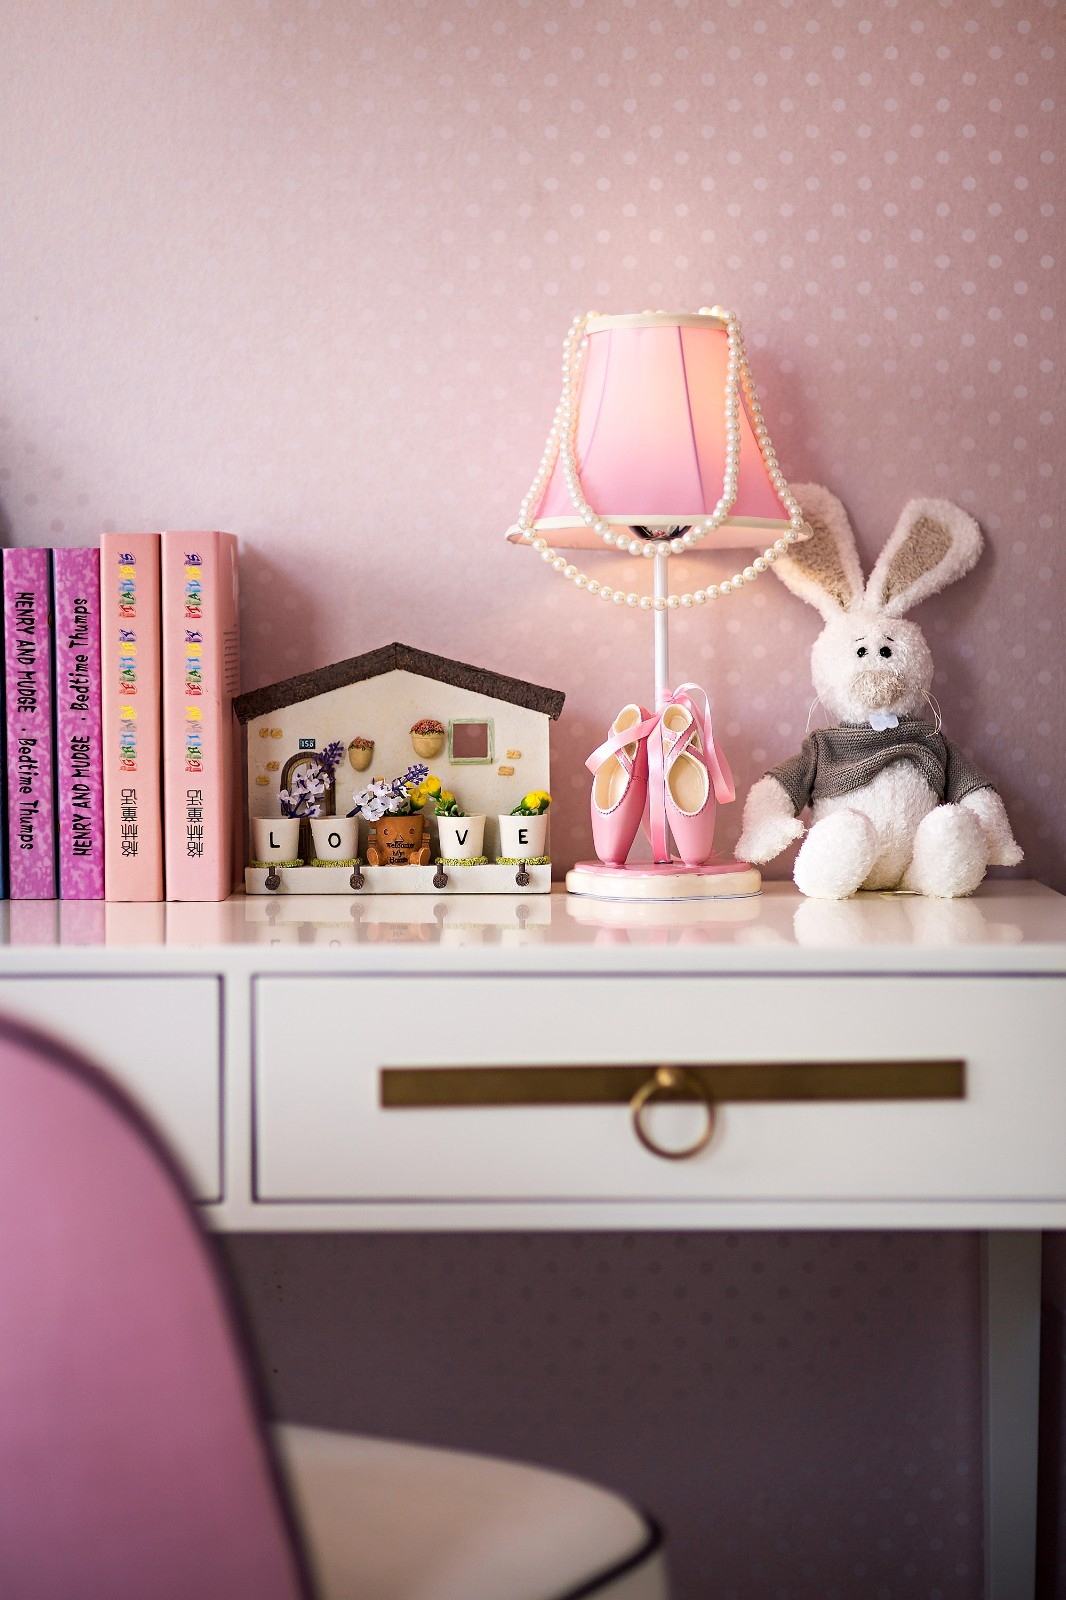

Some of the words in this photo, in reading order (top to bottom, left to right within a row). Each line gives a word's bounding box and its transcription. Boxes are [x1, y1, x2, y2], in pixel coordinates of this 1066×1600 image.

[118, 552, 136, 618] TALES
[183, 552, 202, 619] TALES
[15, 593, 35, 634] HENRY
[68, 599, 90, 648] Thumps
[16, 640, 35, 664] AND
[119, 629, 137, 695] FAIRY
[184, 629, 203, 696] FAIRY
[17, 671, 37, 713] MUDGE
[69, 655, 89, 710] Bedtime
[18, 738, 38, 794] Bedtime
[71, 736, 90, 777] MUDGE
[120, 706, 138, 772] GRIMM
[185, 706, 204, 773] GRIMM
[72, 784, 91, 808] AND
[120, 789, 138, 857] 格林童话
[19, 800, 39, 850] Thumps
[72, 814, 92, 855] HENRY
[186, 790, 204, 858] 格林童话
